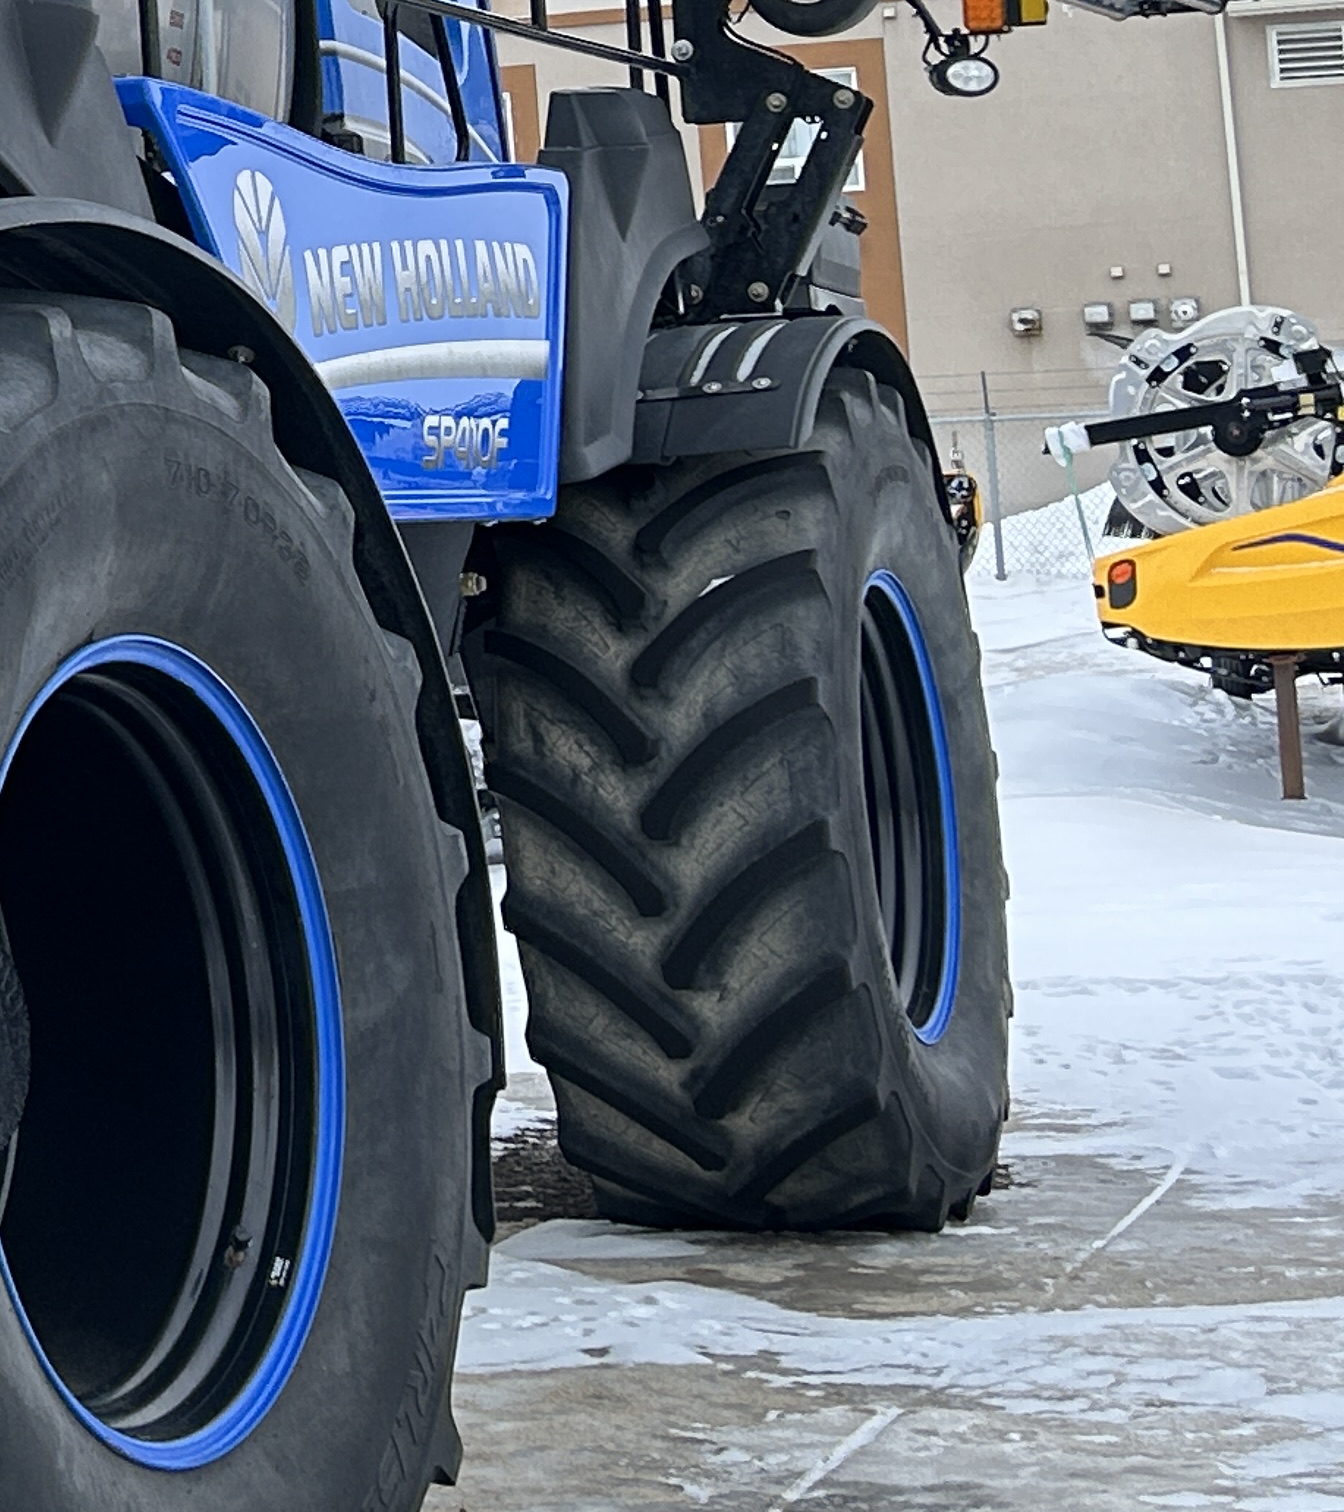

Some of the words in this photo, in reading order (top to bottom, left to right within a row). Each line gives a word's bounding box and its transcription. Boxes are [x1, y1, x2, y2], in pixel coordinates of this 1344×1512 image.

[303, 241, 387, 337] NEW
[390, 239, 542, 323] HOLLAND
[422, 414, 511, 471] SP410F
